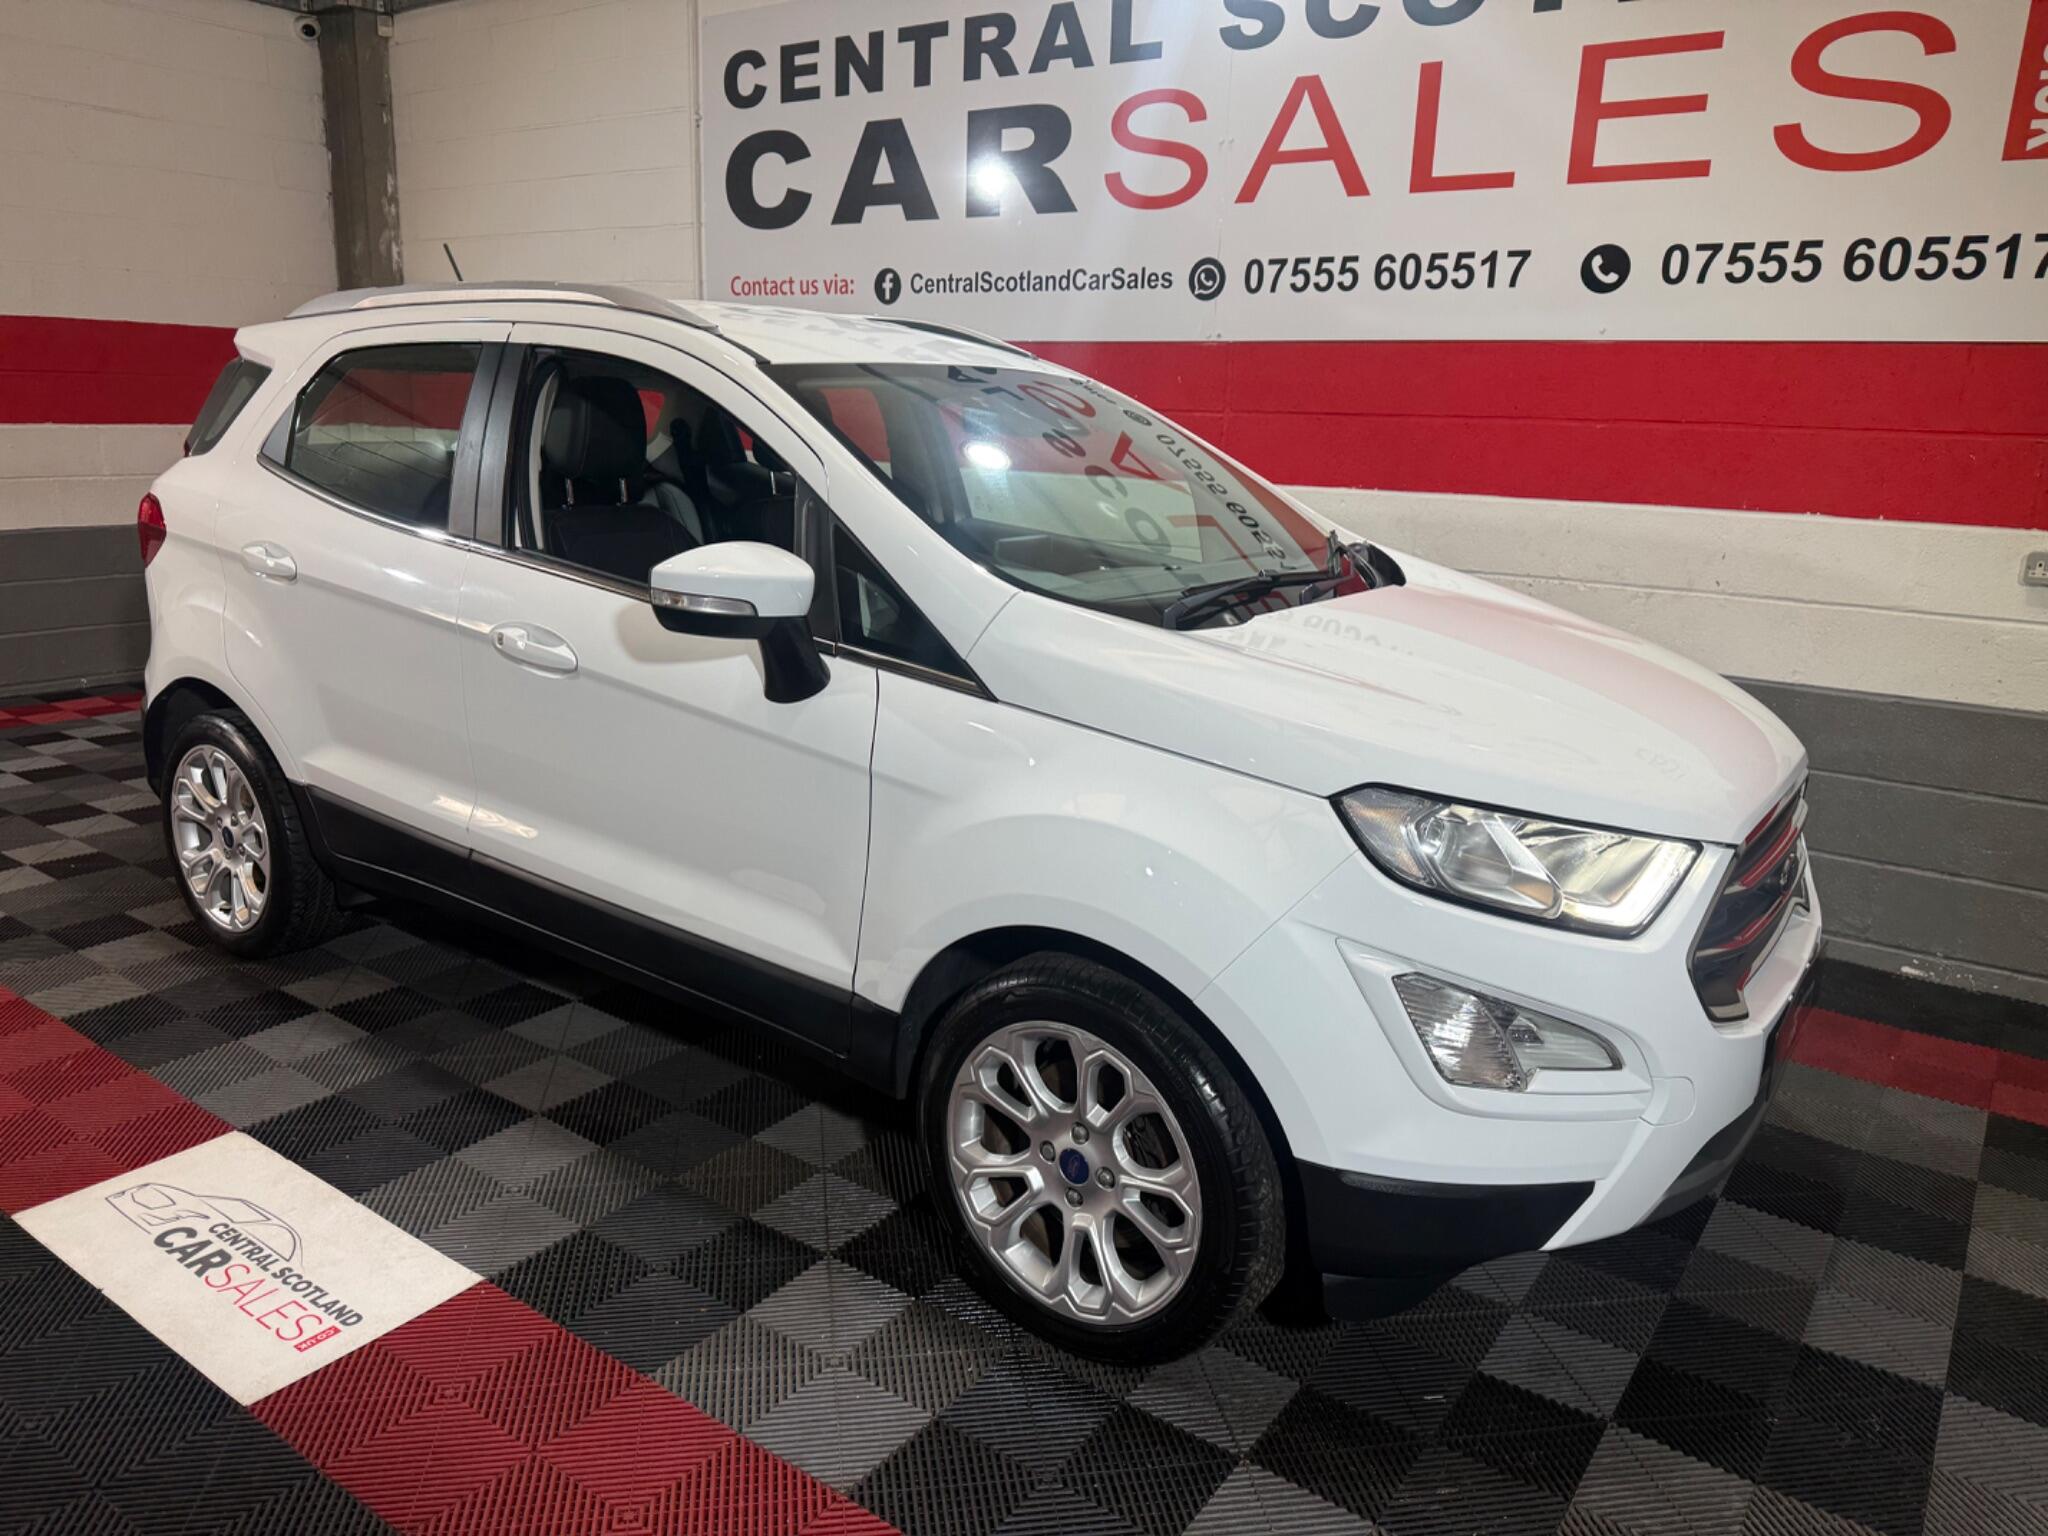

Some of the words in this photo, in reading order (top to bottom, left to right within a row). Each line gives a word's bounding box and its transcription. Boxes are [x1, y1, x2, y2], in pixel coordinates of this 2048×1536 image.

[723, 0, 1164, 110] CENTRAL
[729, 273, 796, 298] Contact
[799, 278, 821, 297] us
[822, 273, 856, 296] via:
[910, 266, 1174, 294] CentralScotlandCarSales
[1244, 255, 1360, 295] 07555
[1374, 249, 1532, 291] 605517
[1661, 239, 1824, 286] 07555
[208, 1222, 281, 1273] CENTRAL
[271, 1266, 364, 1328] SCOTLAND
